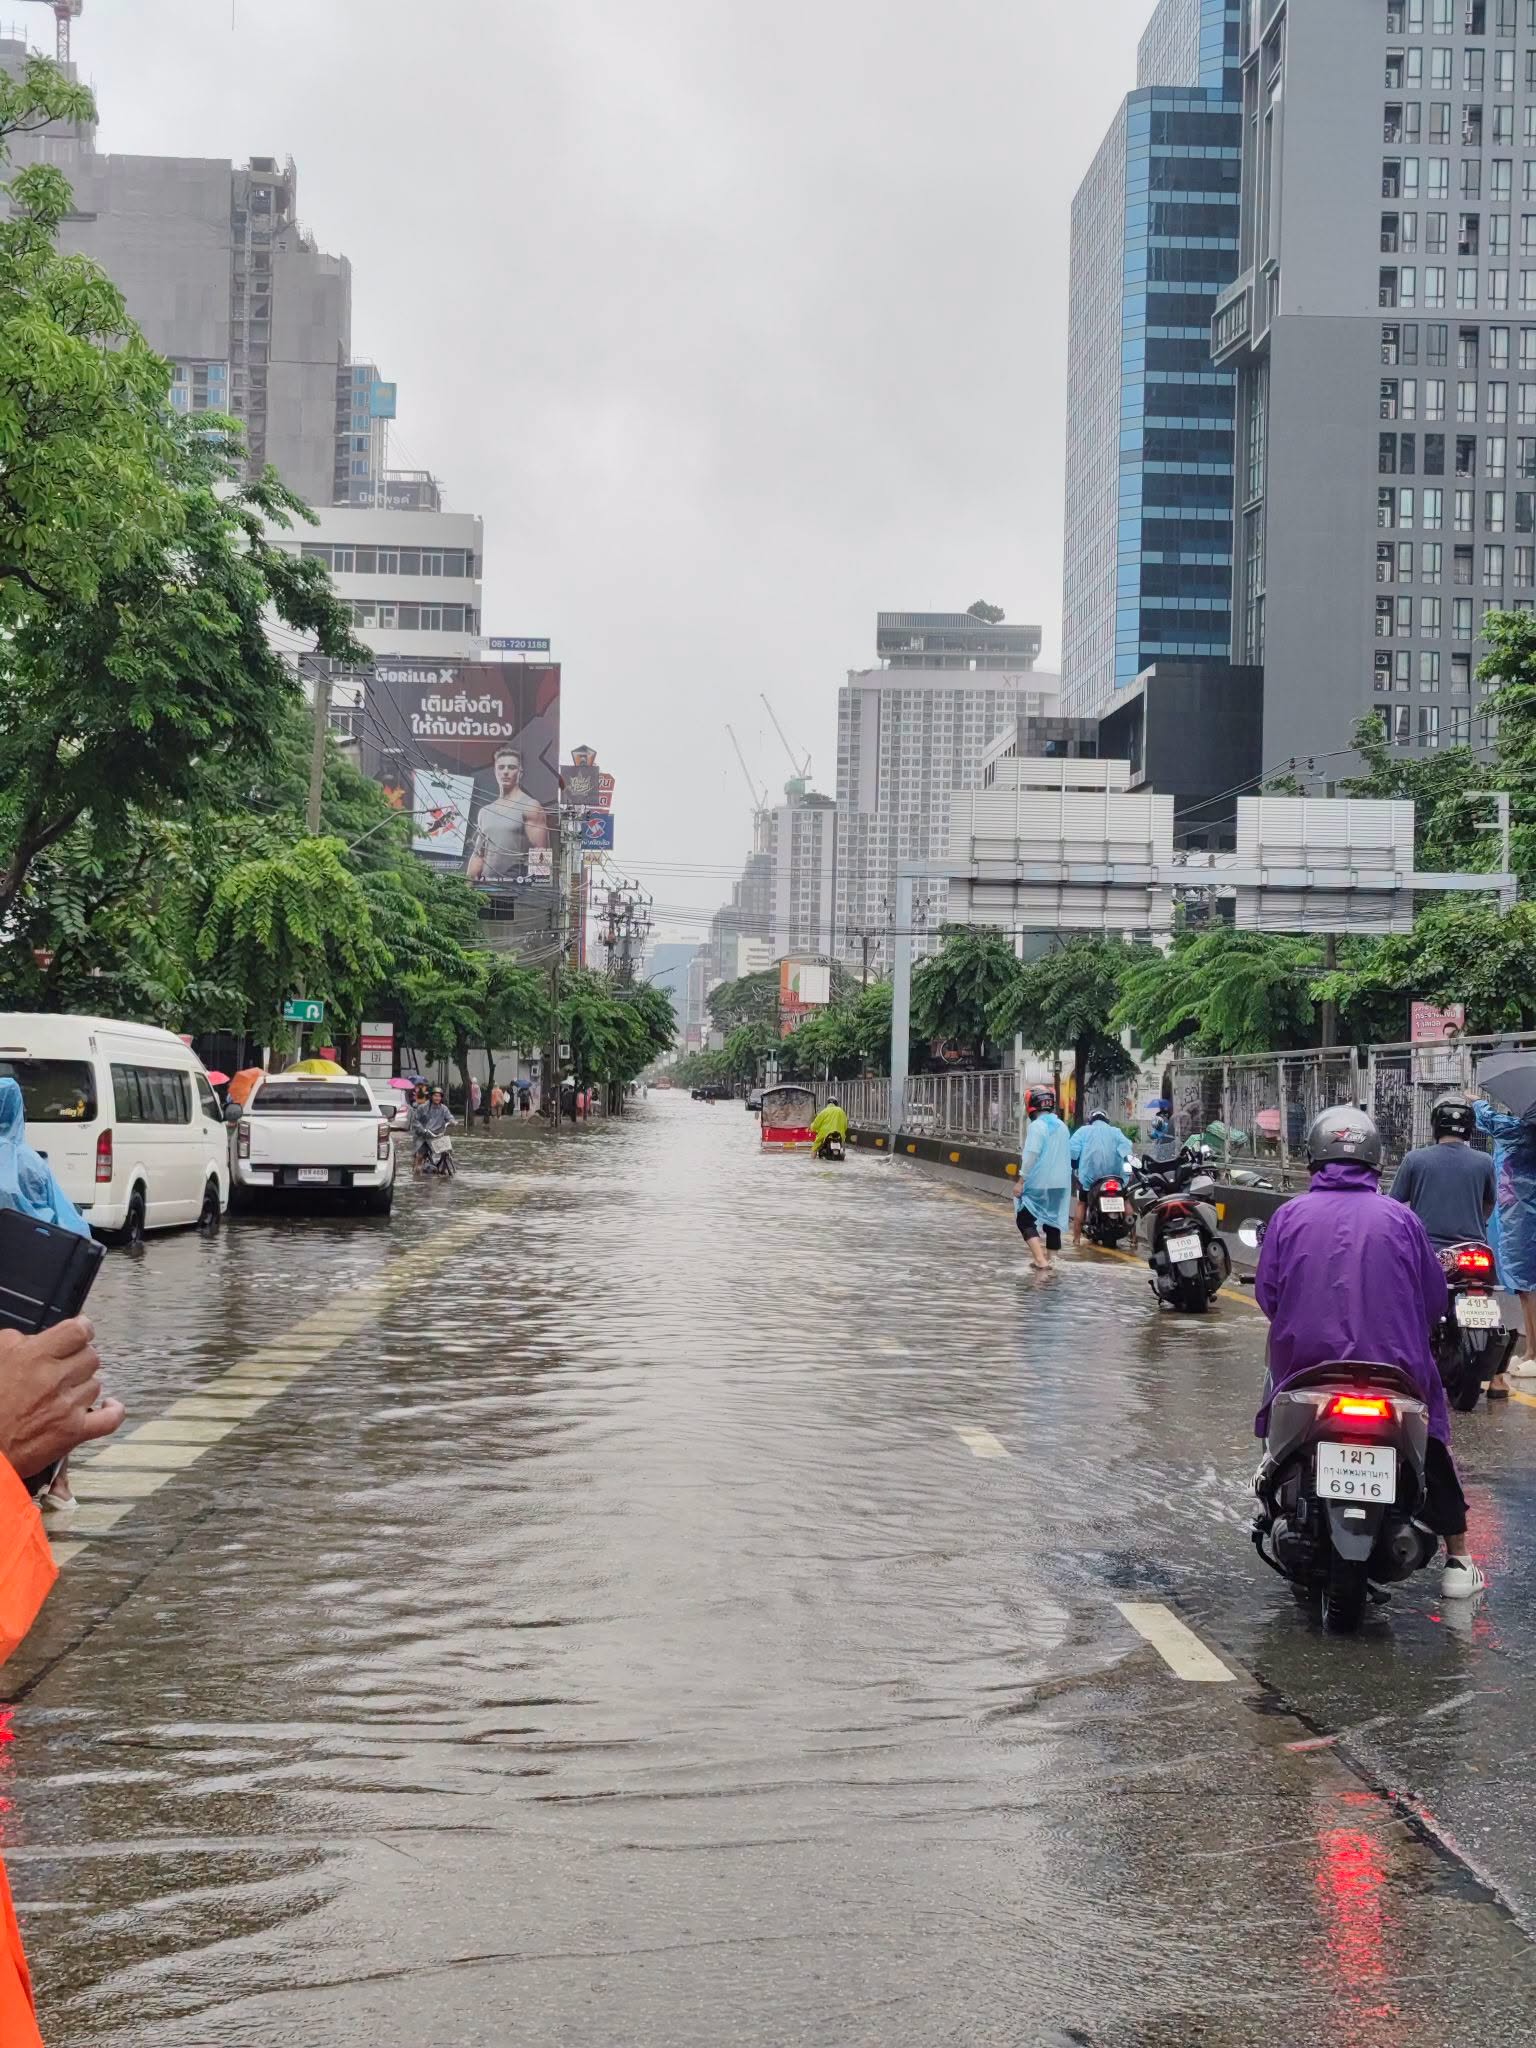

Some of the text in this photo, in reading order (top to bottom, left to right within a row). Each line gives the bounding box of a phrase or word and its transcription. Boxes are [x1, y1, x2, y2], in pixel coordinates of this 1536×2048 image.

[440, 669, 453, 683] X
[421, 690, 503, 717] เติมสิ่งดีๆ
[411, 713, 512, 736] ให้กับตัวเอง
[1464, 1317, 1494, 1326] 9557
[1340, 1449, 1375, 1465] 1ฆว
[1323, 1466, 1390, 1479] กรุงเทพมหานคร
[1330, 1480, 1381, 1497] 6916
